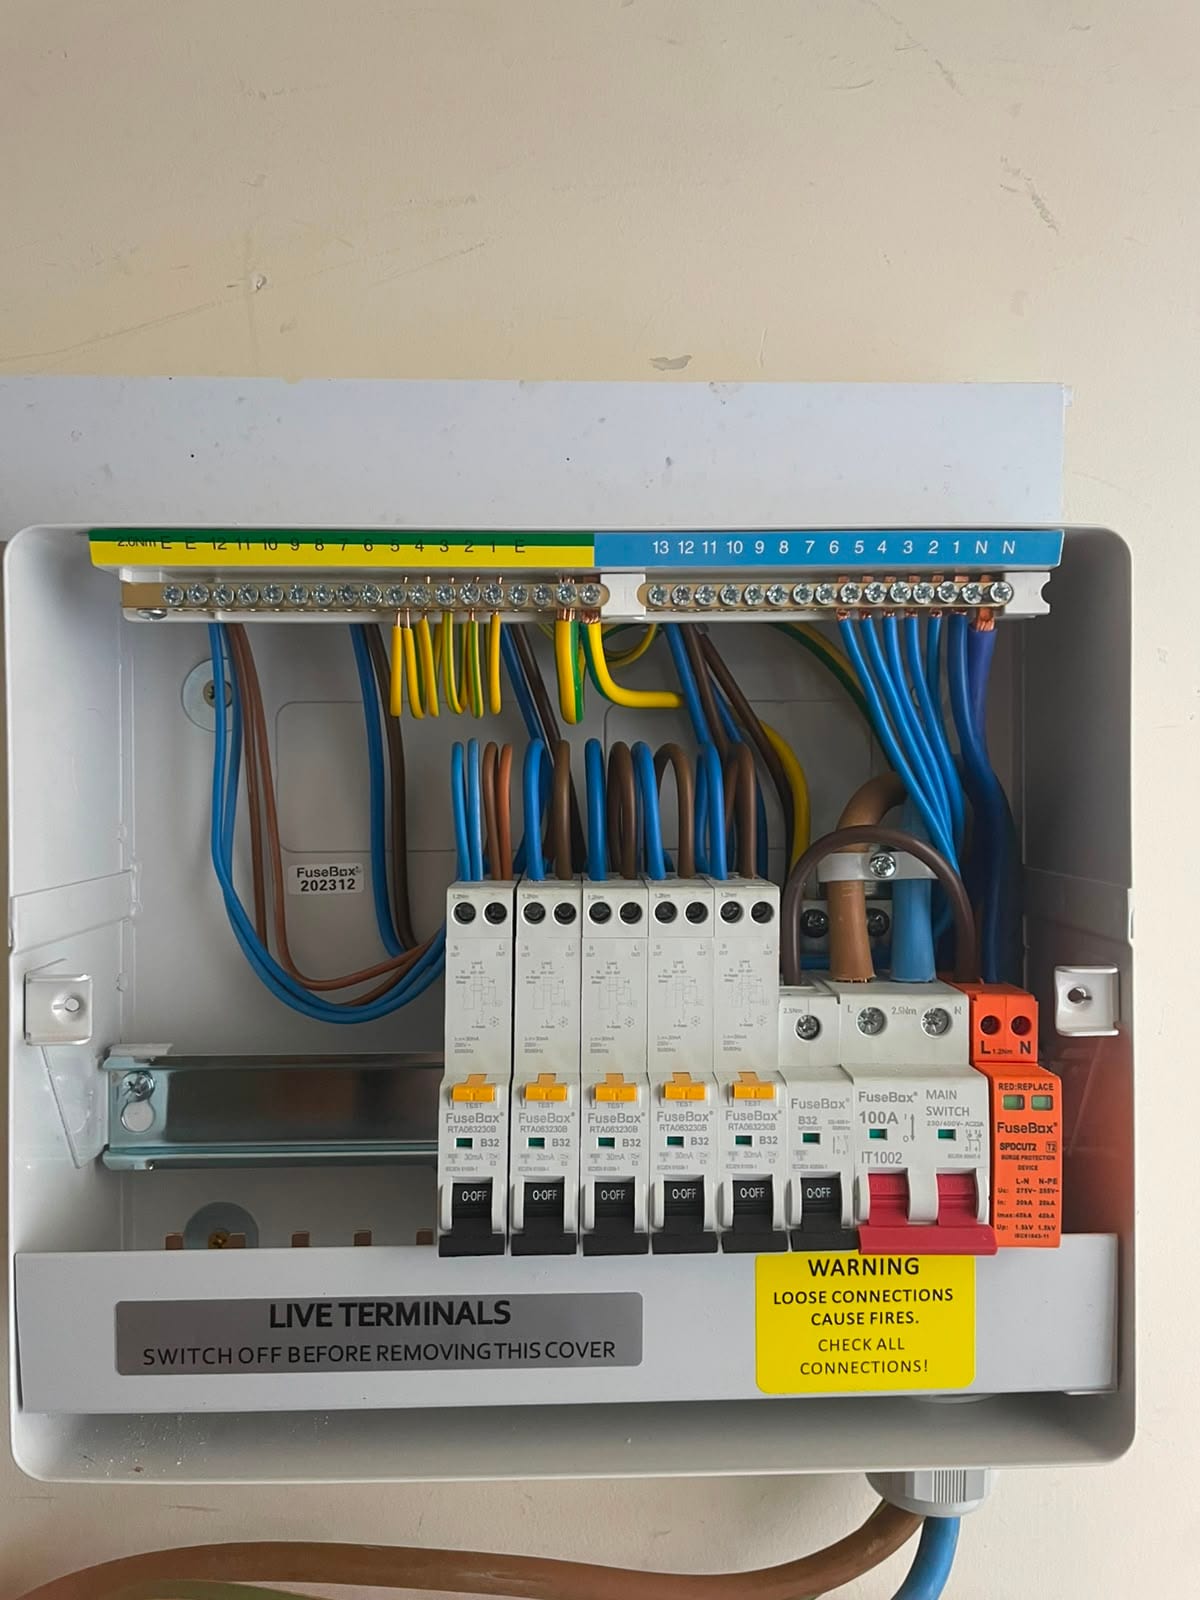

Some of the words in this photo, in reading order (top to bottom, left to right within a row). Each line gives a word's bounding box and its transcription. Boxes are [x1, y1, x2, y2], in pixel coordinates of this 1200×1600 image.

[161, 536, 172, 550] E
[185, 536, 196, 550] E
[212, 537, 226, 550] 12
[238, 537, 250, 550] 11
[263, 538, 277, 550] 10
[291, 538, 299, 551] 9
[315, 538, 324, 551] 8
[340, 538, 348, 551] 7
[364, 539, 373, 552] 6
[390, 539, 400, 552] 5
[415, 539, 424, 552] 4
[440, 539, 448, 552] 3
[464, 540, 474, 552] 2
[490, 540, 496, 552] 1
[516, 540, 525, 553] E
[652, 540, 669, 554] 13
[678, 540, 694, 554] 12
[702, 540, 716, 554] 11
[726, 540, 744, 554] 10
[755, 540, 764, 554] 9
[779, 540, 789, 554] 8
[805, 540, 815, 554] 7
[829, 540, 840, 554] 6
[854, 540, 864, 554] 5
[877, 540, 887, 554] 4
[903, 540, 913, 554] 3
[928, 540, 938, 554] 2
[954, 540, 960, 554] 1
[975, 540, 988, 554] N
[1002, 540, 1016, 554] N
[300, 878, 356, 892] 202312
[847, 1005, 853, 1013] L
[892, 1007, 916, 1016] 2.5Nm
[980, 1041, 991, 1054] L
[1020, 1041, 1031, 1054] N
[926, 1090, 957, 1100] MAIN
[926, 1106, 970, 1116] SWITCH
[798, 1116, 818, 1125] B32
[859, 1111, 899, 1125] 100A
[480, 1138, 500, 1147] B32
[552, 1138, 571, 1147] B32
[622, 1138, 641, 1147] B32
[690, 1137, 710, 1146] B32
[760, 1136, 778, 1144] B32
[1000, 1142, 1037, 1151] SPDCUT2
[862, 1151, 902, 1164] IT1002
[808, 1257, 920, 1277] WARNING
[774, 1291, 827, 1305] LOOSE
[832, 1288, 954, 1304] CONNECTIONS
[270, 1302, 333, 1328] LIVE
[338, 1300, 511, 1327] TERMINALS
[811, 1312, 865, 1326] CAUSE
[870, 1311, 920, 1324] FIRES.
[818, 1338, 872, 1352] CHECK
[876, 1338, 905, 1350] ALL
[144, 1348, 232, 1366] SWITCH
[238, 1346, 282, 1364] OFF
[288, 1345, 372, 1363] BEFORE
[376, 1343, 491, 1362] REMOVING
[494, 1342, 541, 1360] THIS
[545, 1342, 616, 1359] COVER
[800, 1360, 928, 1375] CONNECTIONS!
